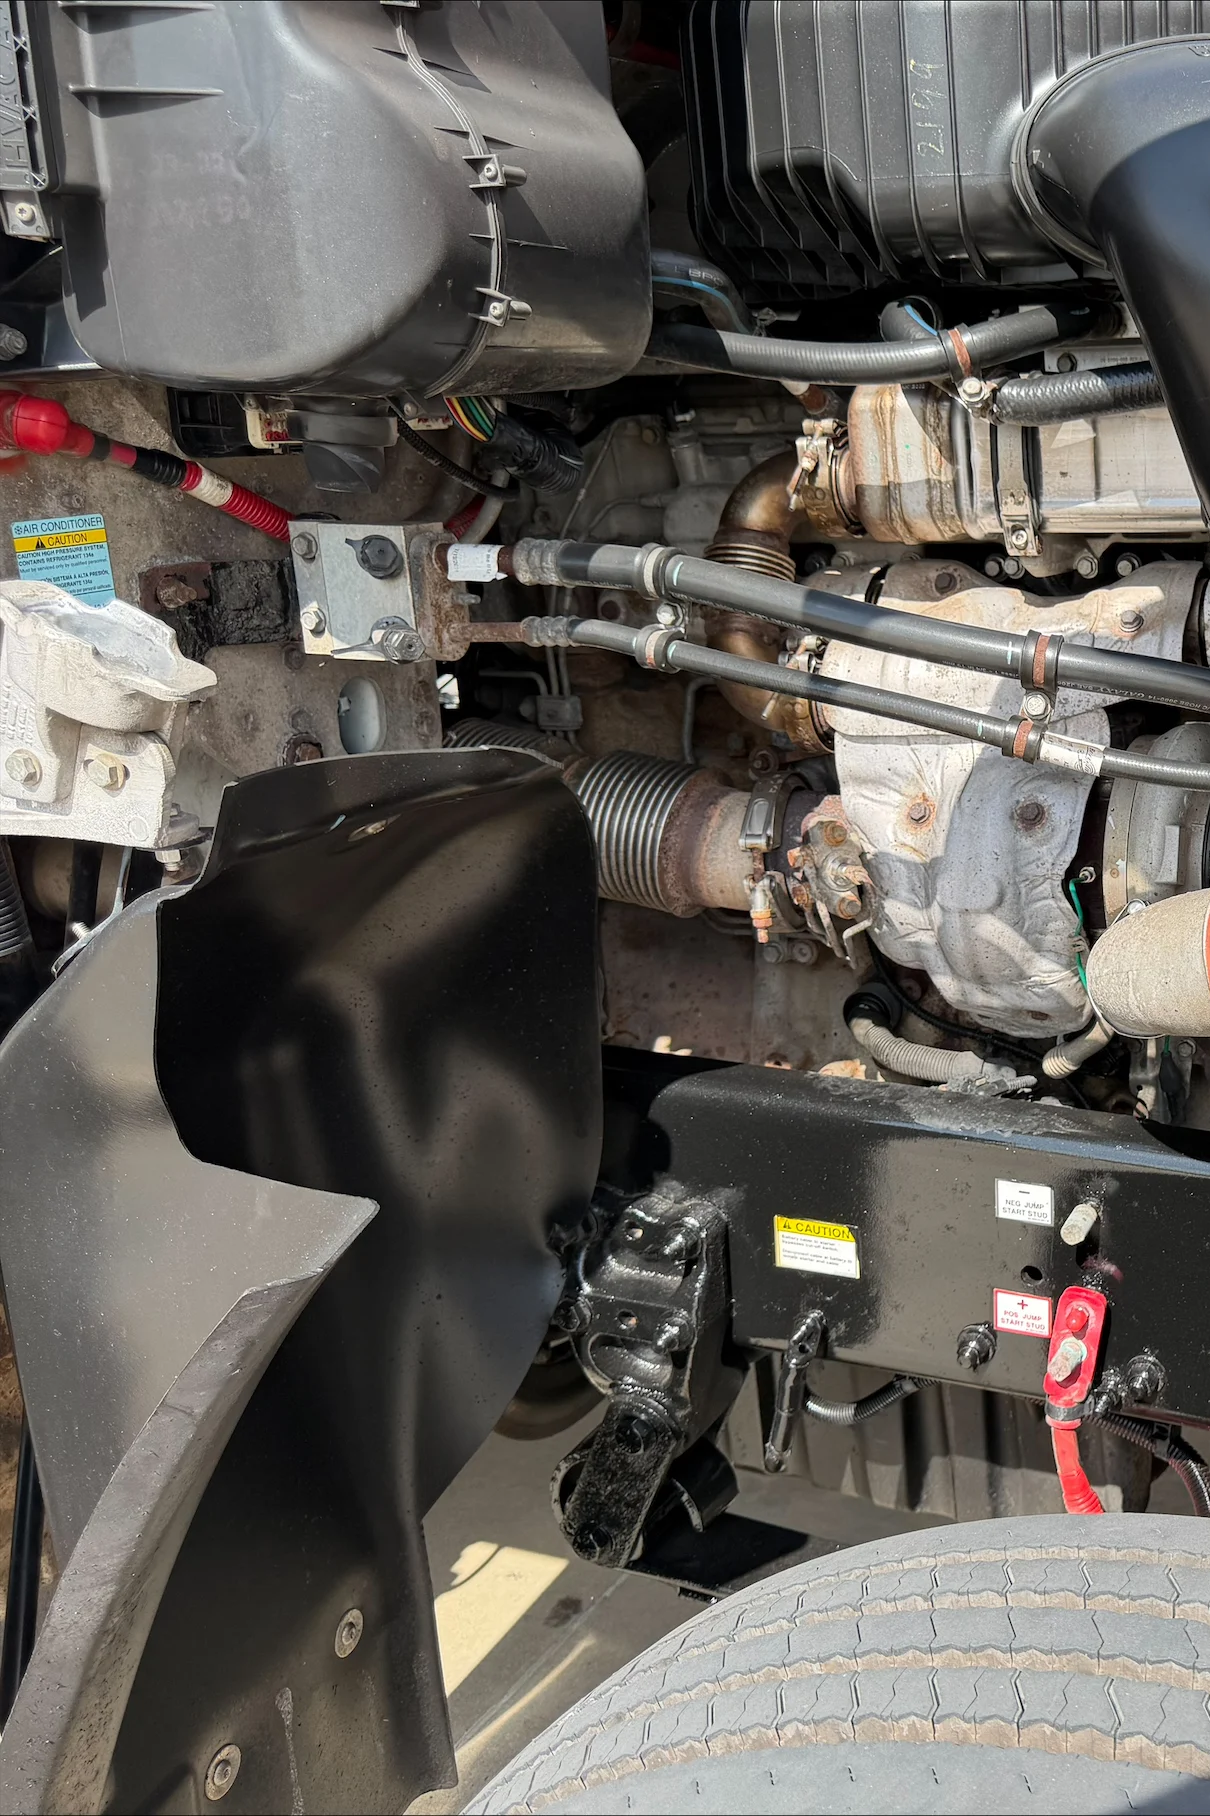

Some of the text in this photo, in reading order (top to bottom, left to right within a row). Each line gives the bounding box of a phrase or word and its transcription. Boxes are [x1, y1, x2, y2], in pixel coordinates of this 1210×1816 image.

[23, 516, 103, 534] AIR CONDITIONER
[47, 532, 88, 546] CAUTION
[18, 552, 41, 560] CAUTION
[56, 546, 82, 554] PRESSURE
[18, 558, 45, 567] CONTAINS
[46, 554, 82, 564] REFRIGERANT
[52, 574, 73, 582] SISTEMA
[1096, 688, 1145, 698] GALAXY
[1005, 1199, 1045, 1210] NEG JUMP
[1002, 1207, 1048, 1219] START STUD
[795, 1222, 850, 1239] CAUTION
[1004, 1310, 1042, 1321] POS JUMP
[1001, 1317, 1046, 1331] START STUD
